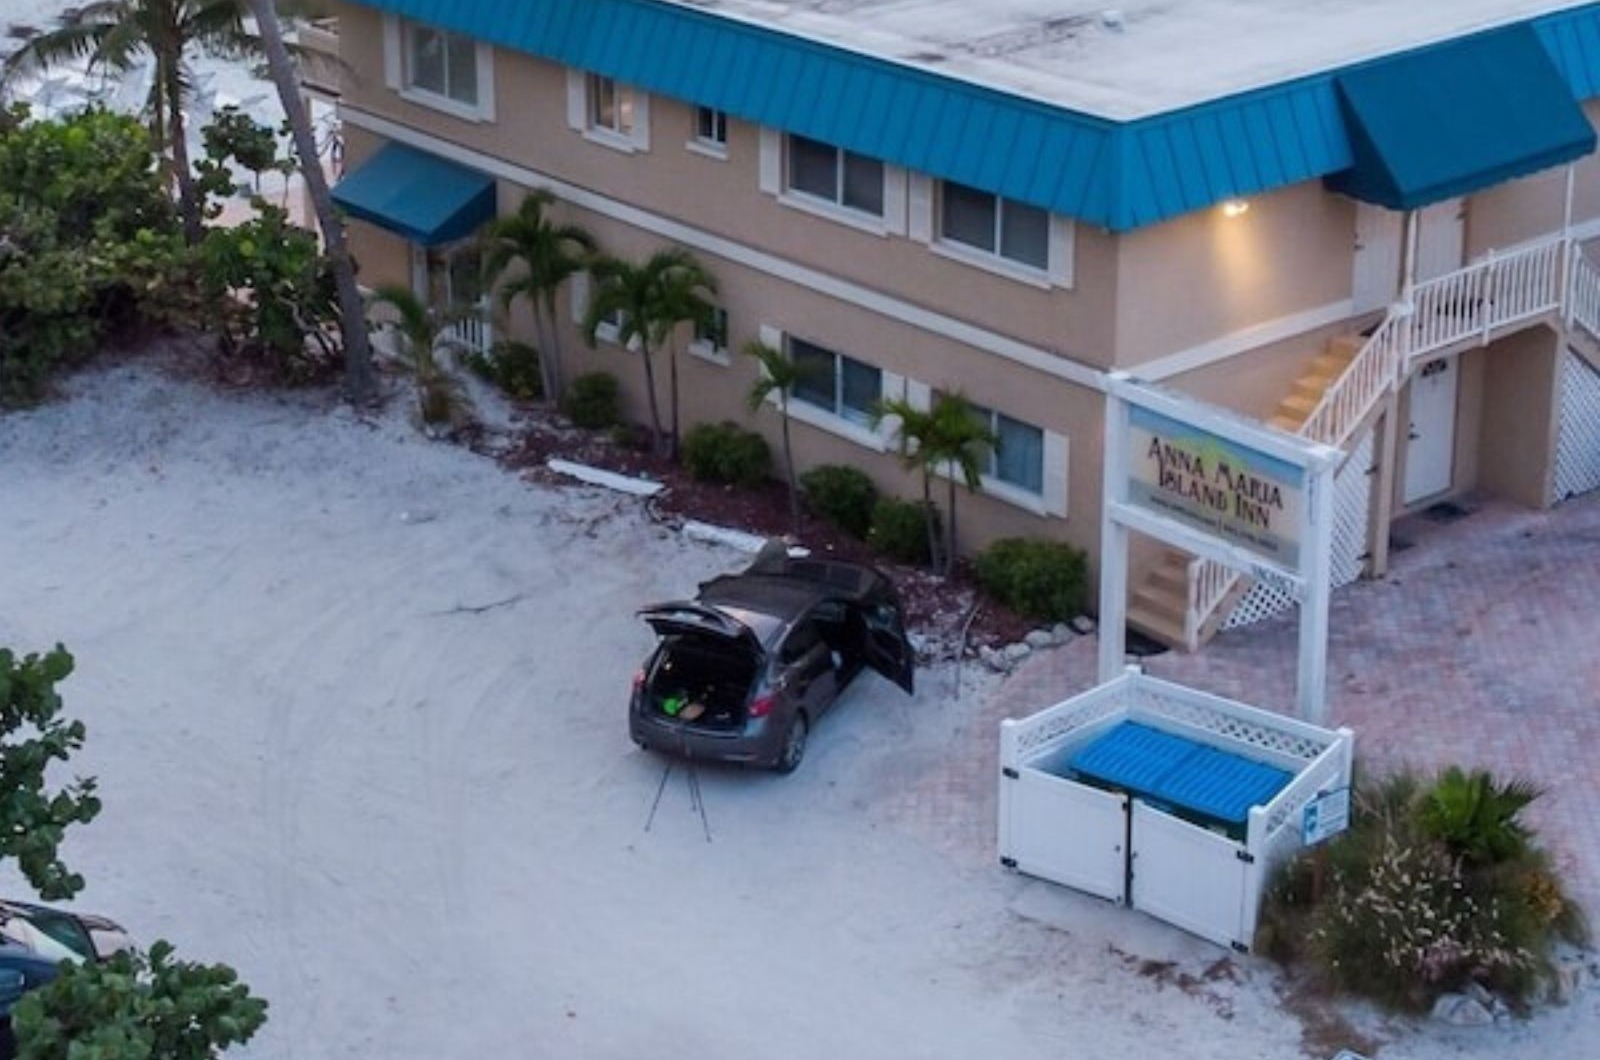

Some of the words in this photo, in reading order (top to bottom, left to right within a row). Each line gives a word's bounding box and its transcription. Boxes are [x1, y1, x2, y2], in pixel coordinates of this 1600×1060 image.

[1148, 436, 1205, 479] ANNA
[1215, 461, 1284, 510] MARIA
[1158, 455, 1228, 513] ISLAND
[1235, 492, 1271, 529] INN
